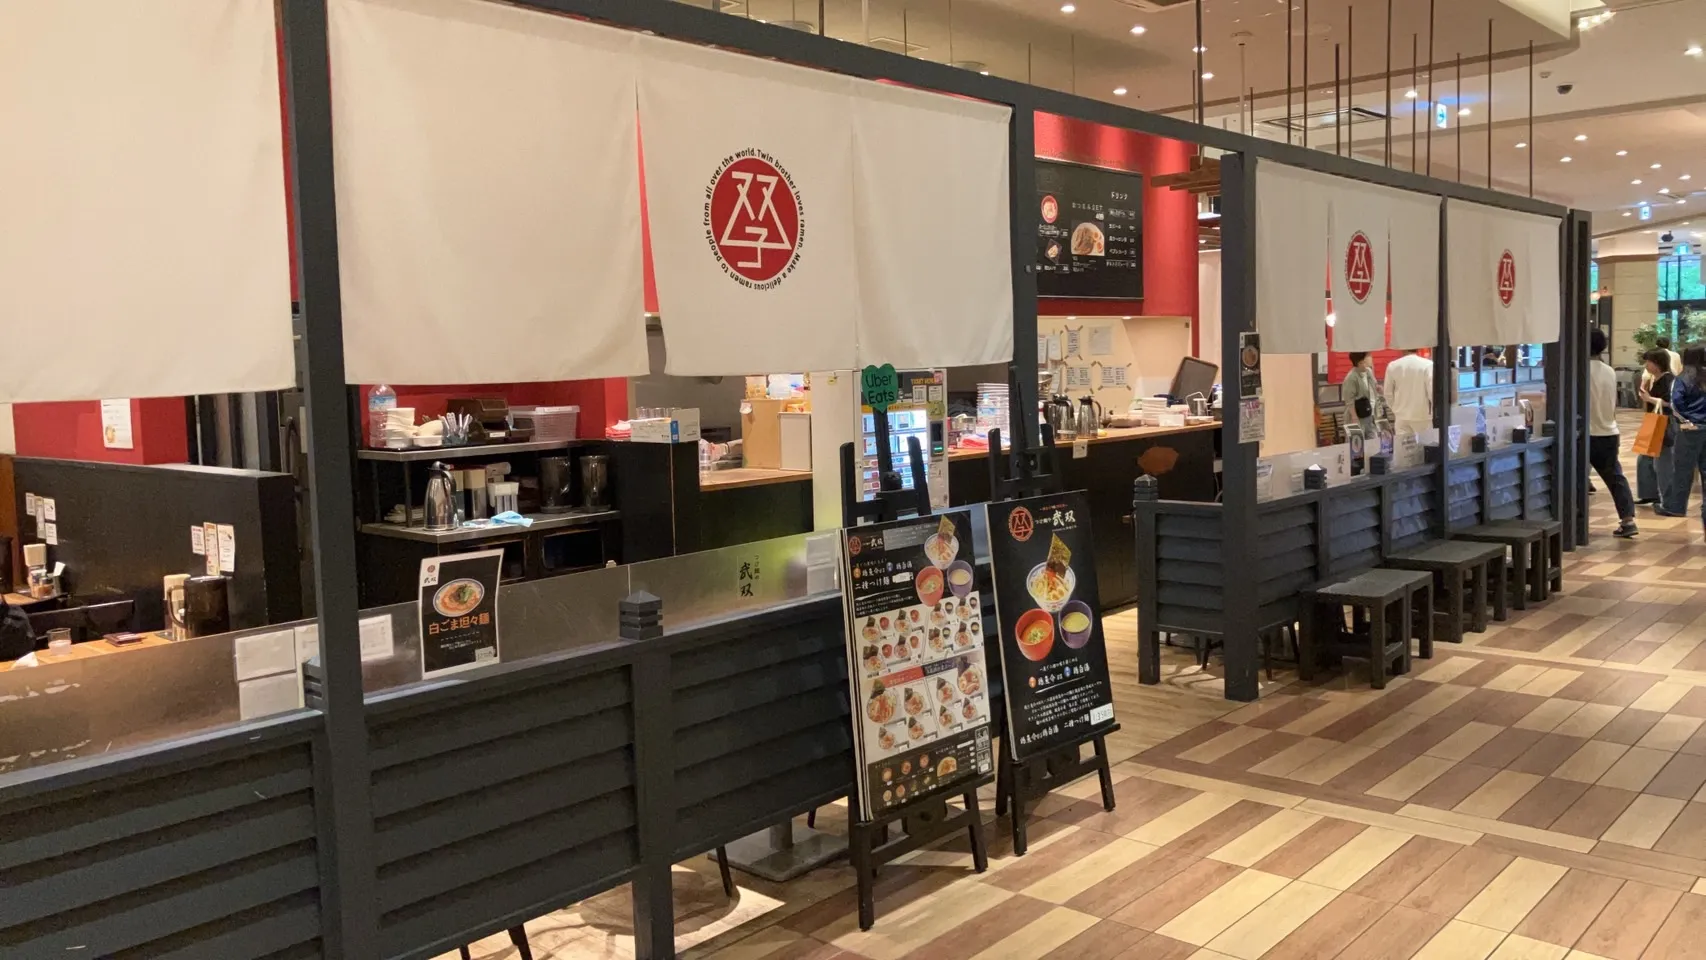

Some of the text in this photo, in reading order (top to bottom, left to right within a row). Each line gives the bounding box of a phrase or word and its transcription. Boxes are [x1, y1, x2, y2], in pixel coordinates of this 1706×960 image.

[721, 154, 735, 168] the
[757, 149, 774, 164] Twin
[710, 165, 723, 186] over
[774, 159, 797, 191] brother
[704, 186, 713, 201] all
[794, 190, 804, 216] loves
[705, 229, 722, 263] people
[720, 262, 730, 275] to
[786, 252, 801, 274] Make
[729, 271, 753, 290] ramen
[753, 276, 782, 292] delicious
[865, 373, 892, 388] Uber
[868, 390, 895, 404] Eats
